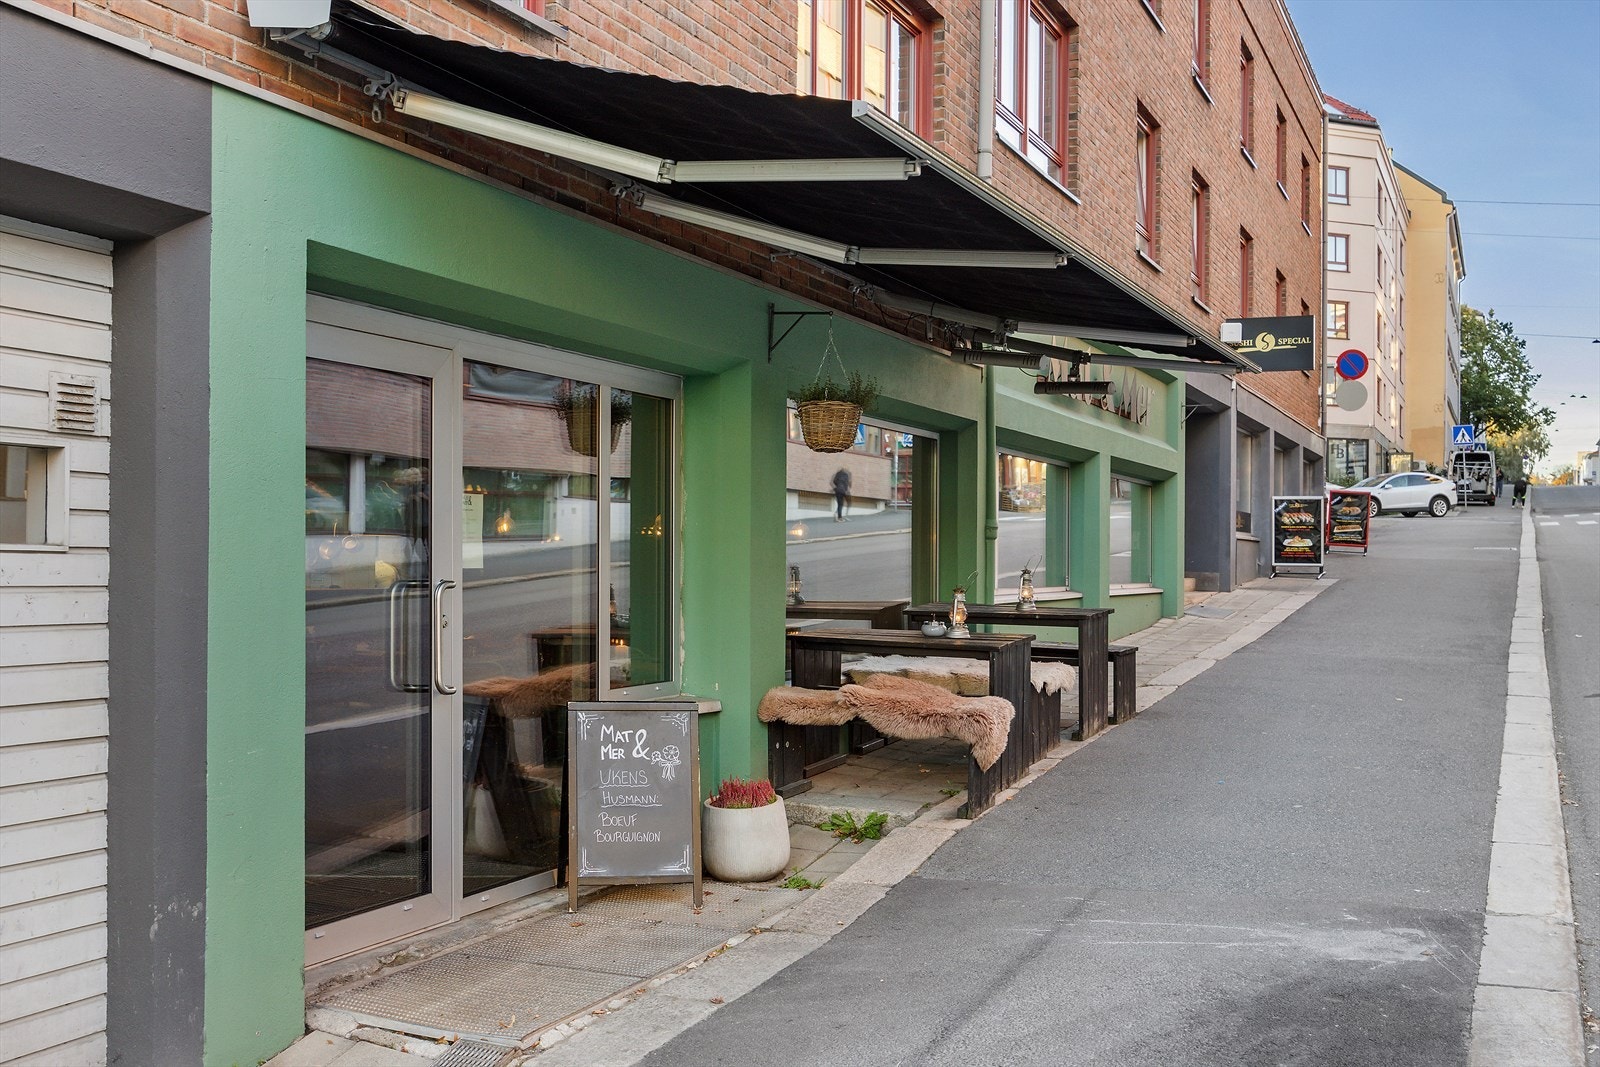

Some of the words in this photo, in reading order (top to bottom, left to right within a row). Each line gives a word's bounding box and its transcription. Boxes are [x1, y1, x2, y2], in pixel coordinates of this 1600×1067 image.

[1278, 337, 1312, 345] SPECIAL
[600, 724, 634, 743] MAT
[632, 729, 651, 760] &
[600, 743, 626, 760] MER
[599, 769, 648, 785] UKENS
